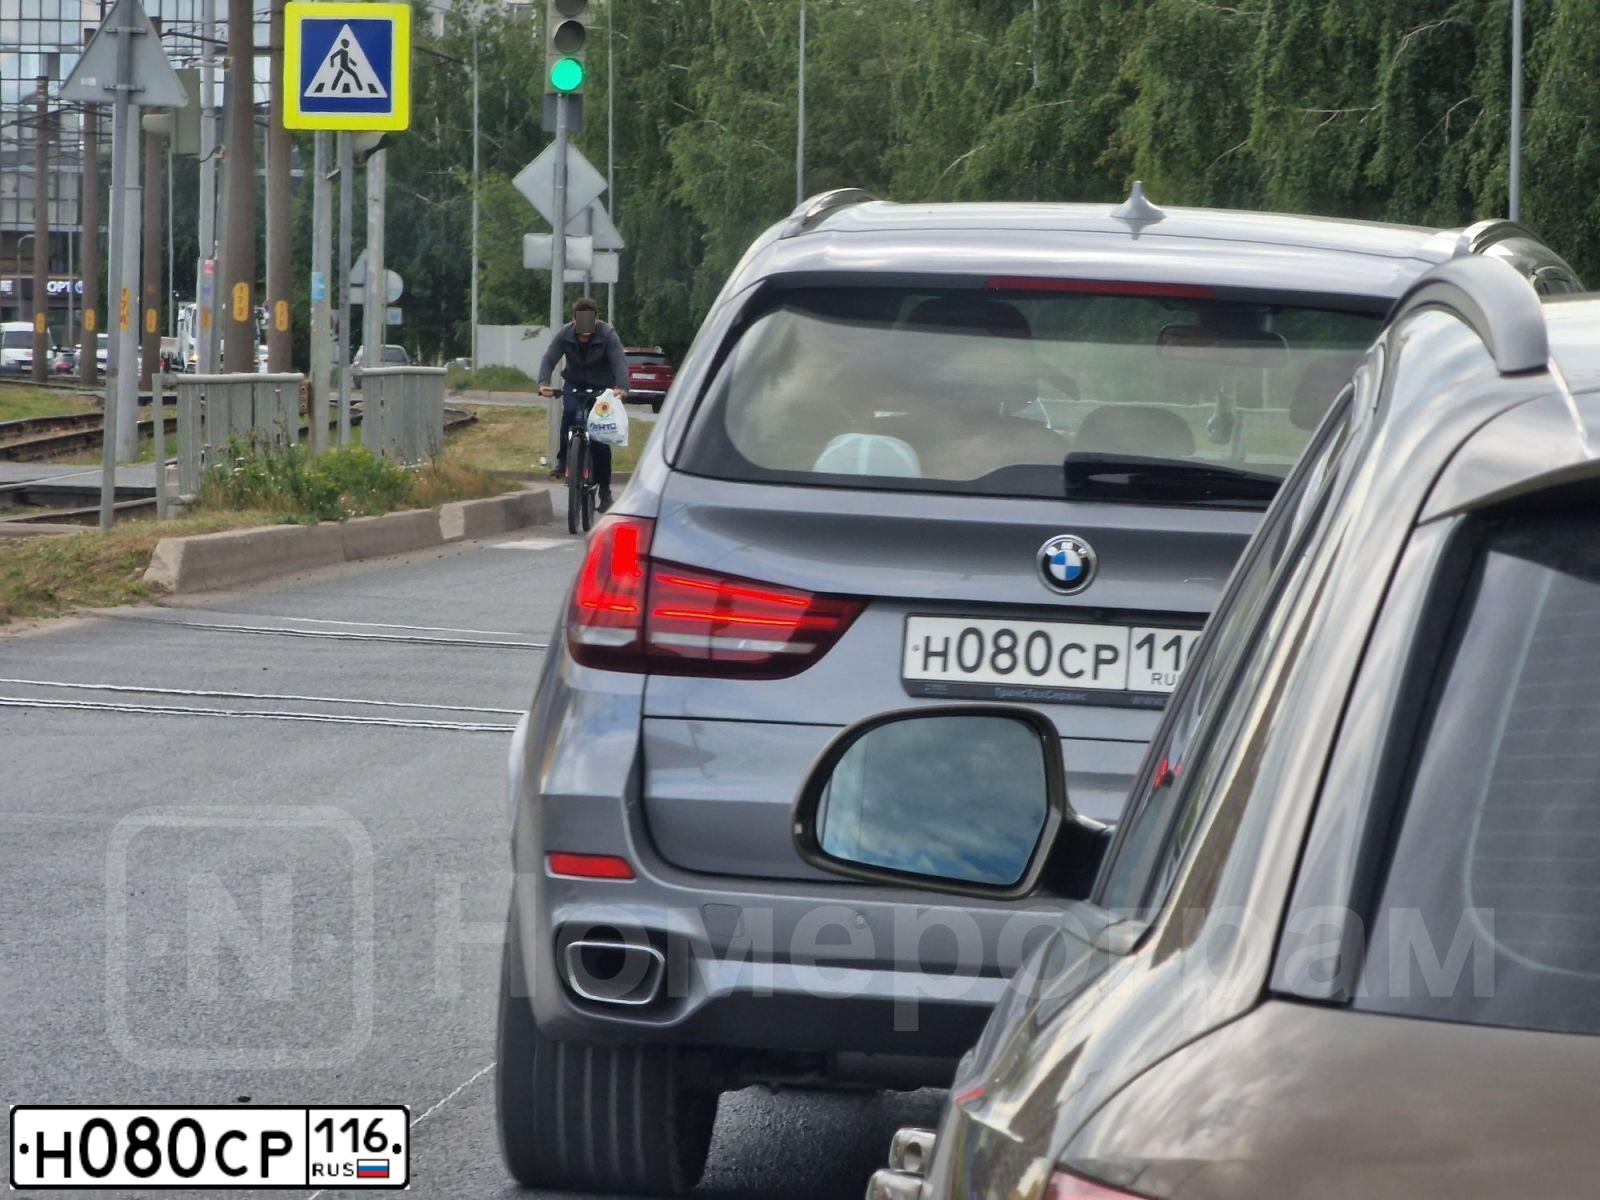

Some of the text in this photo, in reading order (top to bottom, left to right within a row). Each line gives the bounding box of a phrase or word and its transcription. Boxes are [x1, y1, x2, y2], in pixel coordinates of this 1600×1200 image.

[921, 627, 1200, 680] Н080СР 11
[1150, 672, 1177, 686] RU
